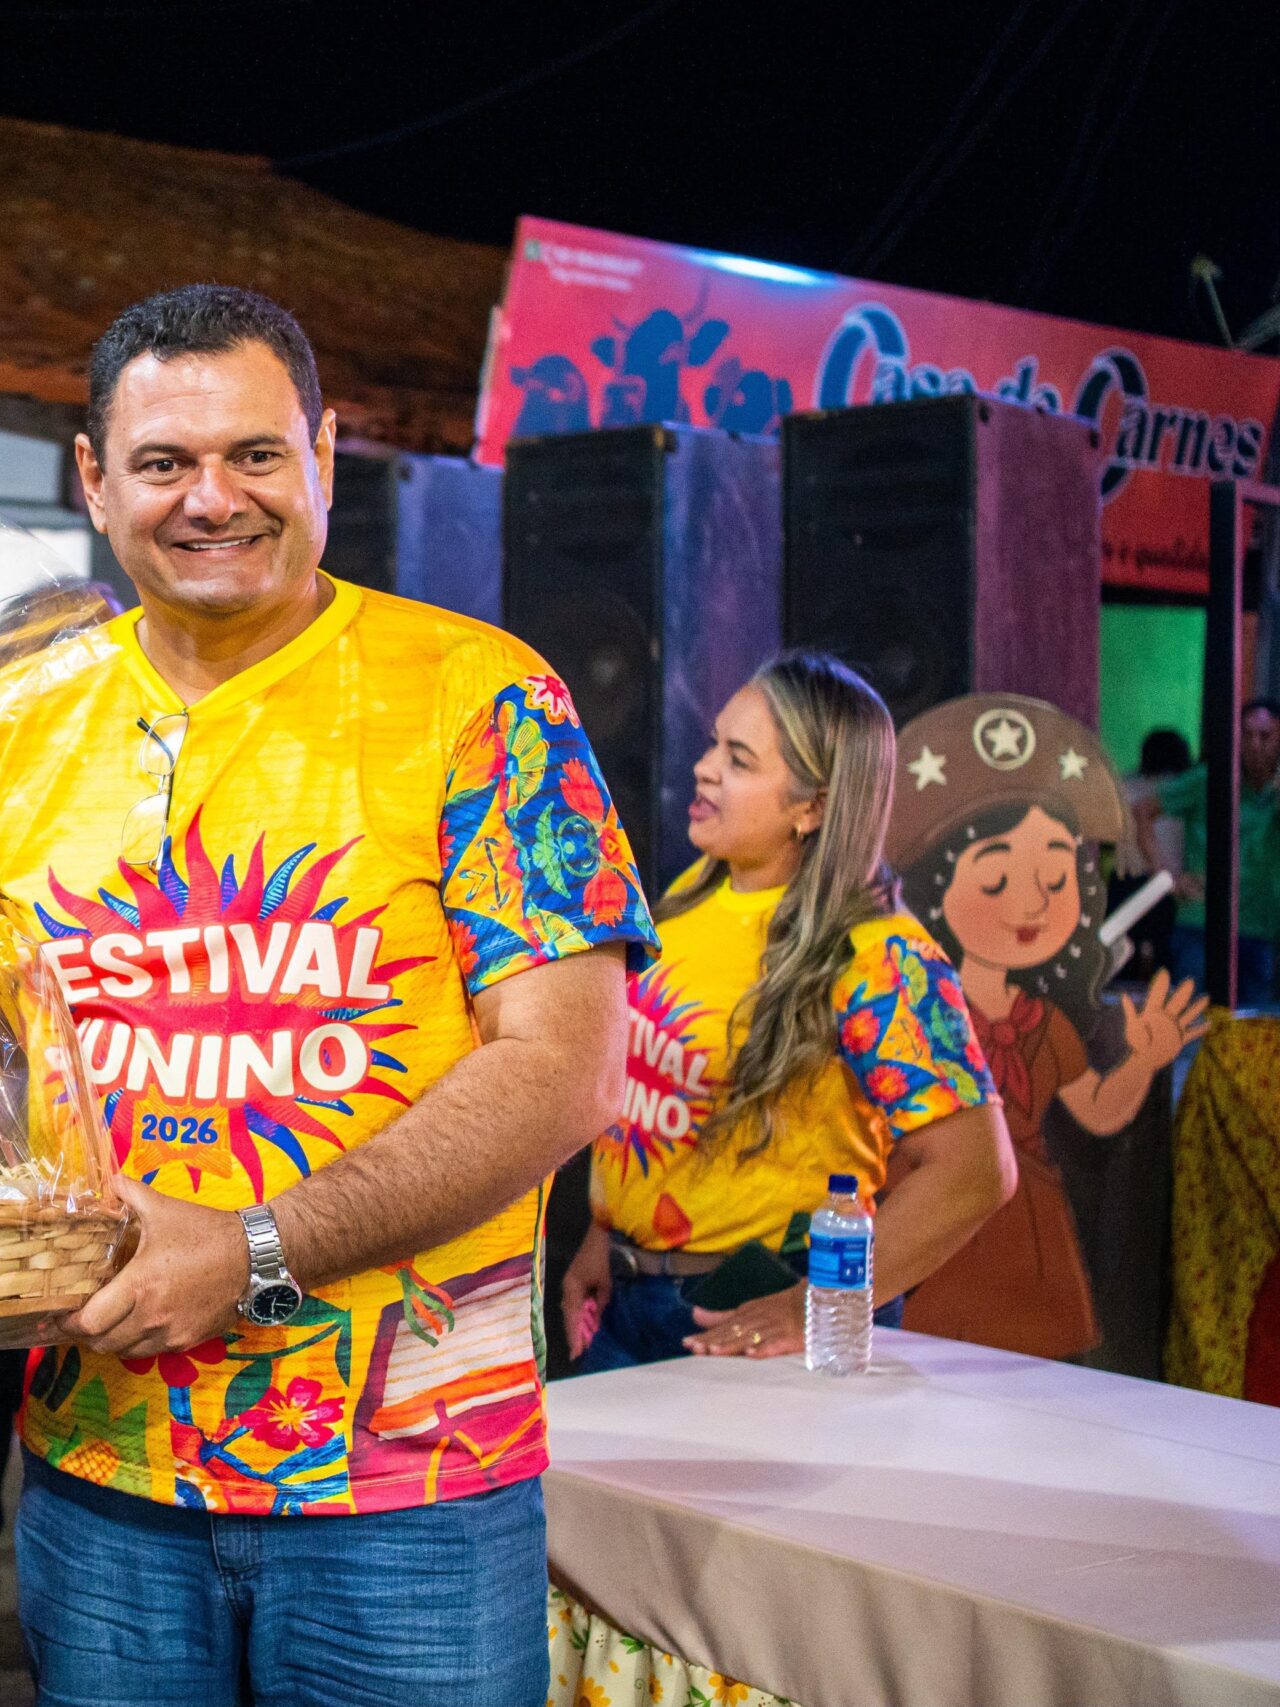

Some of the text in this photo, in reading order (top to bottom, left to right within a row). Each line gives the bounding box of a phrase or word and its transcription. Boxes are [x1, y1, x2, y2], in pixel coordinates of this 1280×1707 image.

[1071, 346, 1265, 505] Carnes
[626, 1004, 711, 1097] IVAL
[140, 1113, 219, 1145] 2026
[621, 1076, 691, 1139] INO
